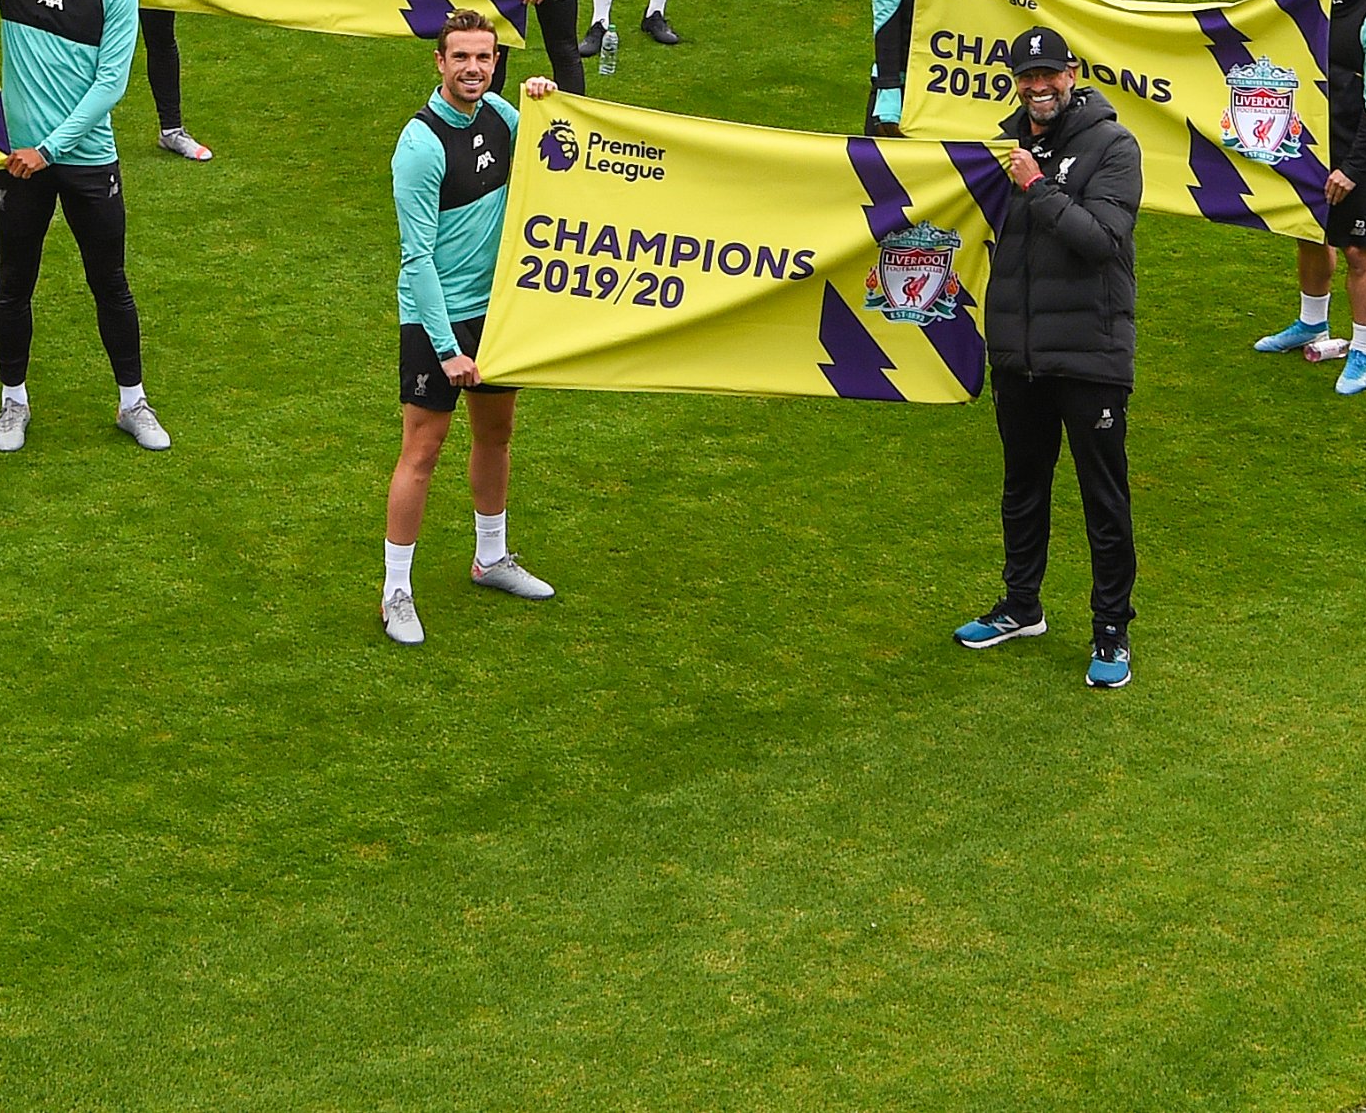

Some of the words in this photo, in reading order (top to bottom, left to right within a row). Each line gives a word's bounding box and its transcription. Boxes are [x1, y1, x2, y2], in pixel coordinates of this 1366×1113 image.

[930, 31, 1171, 102] CHAIONS
[927, 64, 1018, 106] 2019/
[1235, 96, 1289, 107] LIVERPOOL
[587, 132, 666, 160] Premier
[585, 155, 664, 182] League
[524, 215, 815, 282] CHAMPIONS
[885, 254, 946, 266] LIVERPOOL
[516, 255, 684, 308] 2019/20
